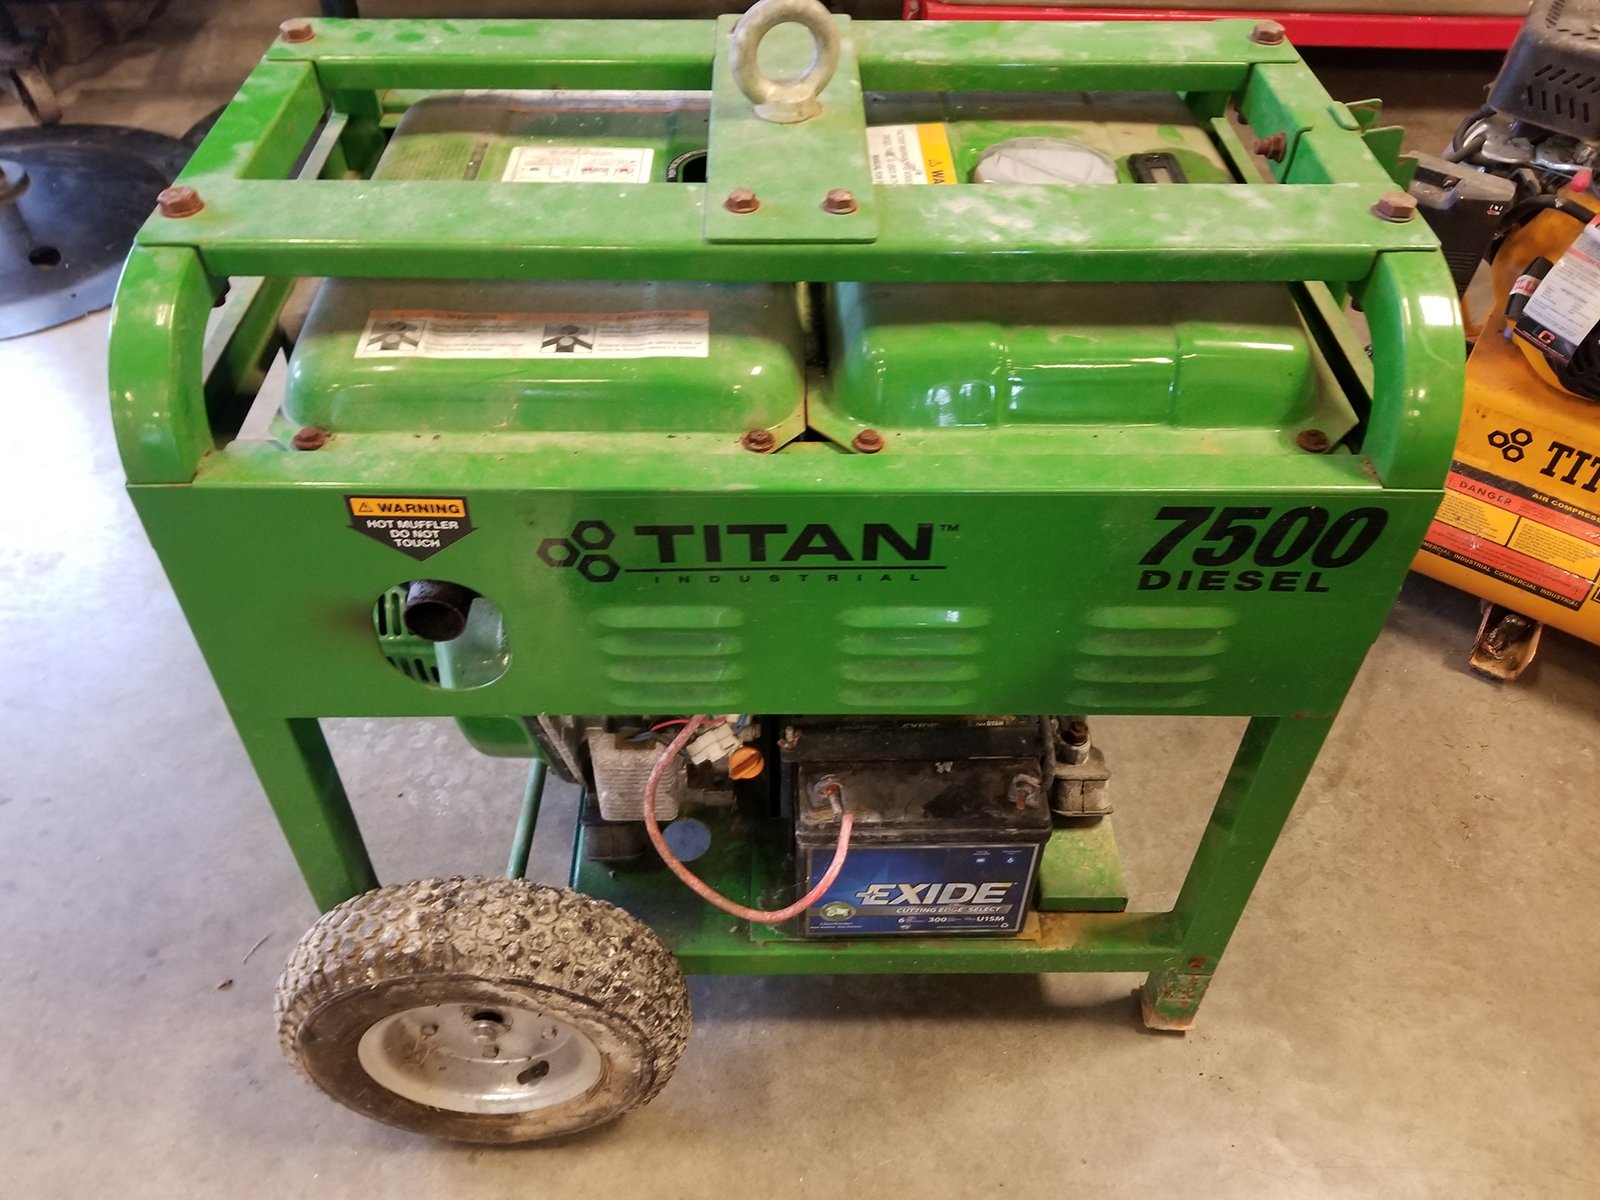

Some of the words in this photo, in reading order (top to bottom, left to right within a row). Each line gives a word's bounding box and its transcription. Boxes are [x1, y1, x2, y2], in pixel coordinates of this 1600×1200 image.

[1459, 481, 1513, 506] DANGER
[1532, 493, 1549, 503] AIR
[377, 503, 460, 514] WARNING
[366, 519, 394, 529] HOT
[396, 520, 459, 530] MUFFLER
[389, 529, 410, 538] DO
[412, 530, 440, 539] NOT
[1138, 506, 1389, 568] 7500
[394, 539, 440, 548] TOUCH
[634, 523, 934, 563] TITAN
[654, 574, 920, 583] INDUSTRIAL
[1137, 570, 1330, 592] DIESEL
[1453, 553, 1491, 572] INDUSTRIAL
[1494, 570, 1537, 591] COMMERCIAL
[1540, 588, 1578, 607] INDUSTRIAL
[856, 882, 1013, 906] EXIDE
[896, 906, 936, 914] CUTTING
[968, 905, 1002, 913] SELECT
